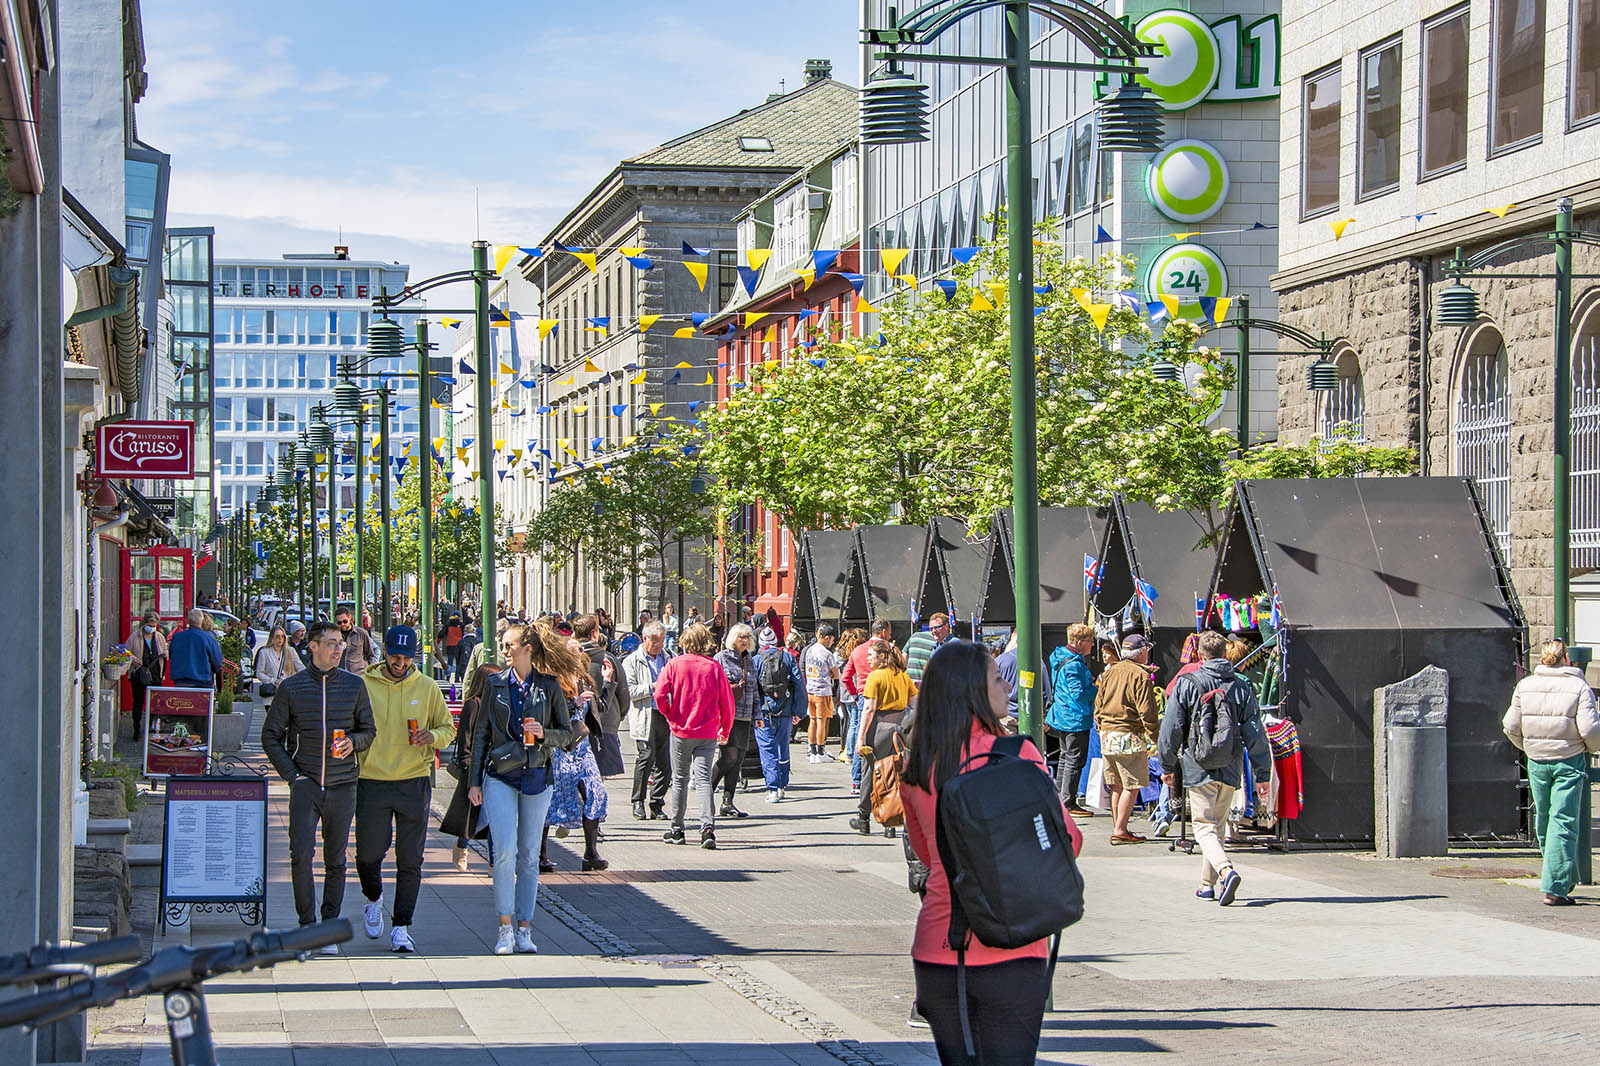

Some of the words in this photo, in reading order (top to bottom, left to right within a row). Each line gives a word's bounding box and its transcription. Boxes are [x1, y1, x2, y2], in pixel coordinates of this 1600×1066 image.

[1169, 270, 1202, 293] 24
[109, 429, 183, 468] Caruso
[137, 433, 180, 441] RISTORANTE
[1033, 813, 1051, 850] THULE
